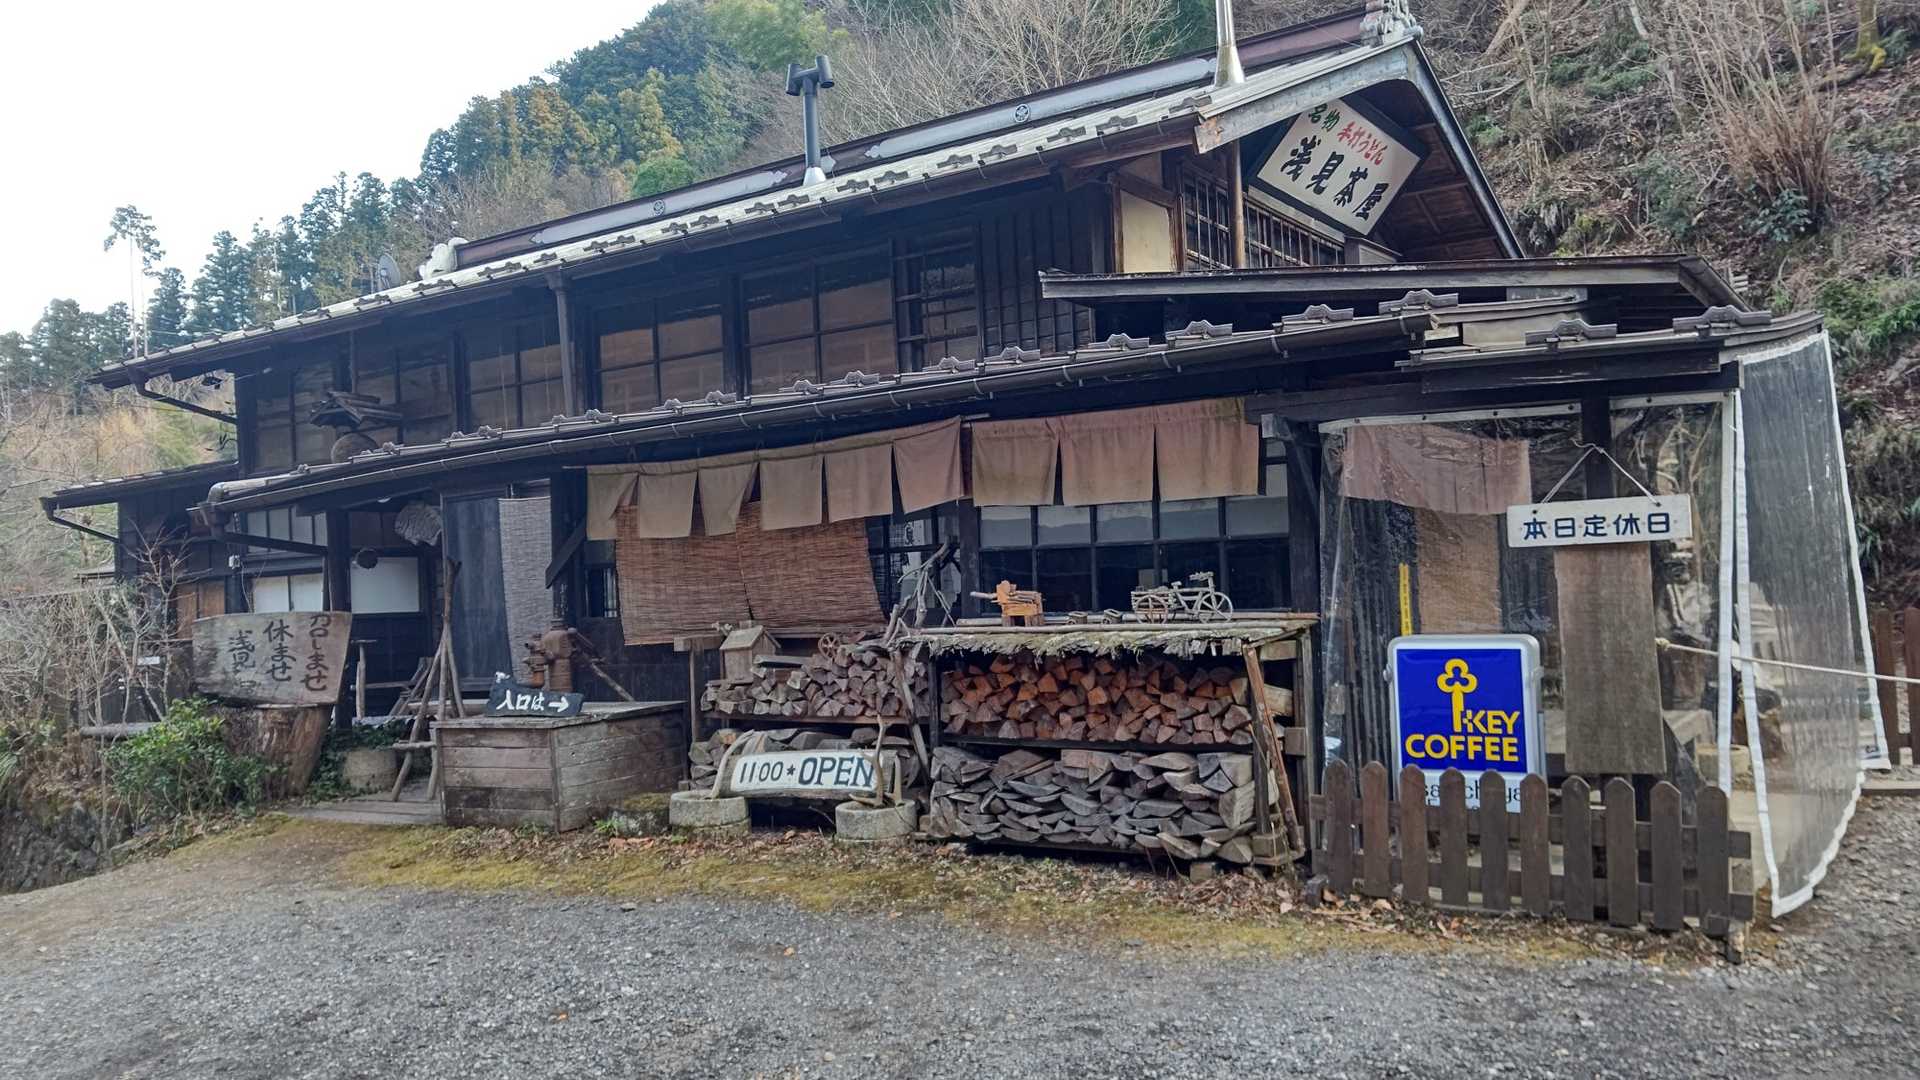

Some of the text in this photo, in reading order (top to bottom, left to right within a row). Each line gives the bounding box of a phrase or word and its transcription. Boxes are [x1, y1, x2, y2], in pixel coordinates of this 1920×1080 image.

[1523, 512, 1670, 540] 本日定休日
[263, 619, 296, 682] 休ませ
[495, 689, 545, 711] 入口は
[1463, 709, 1521, 734] KEY
[1405, 733, 1520, 762] COFFEE
[798, 756, 875, 787] OPEN
